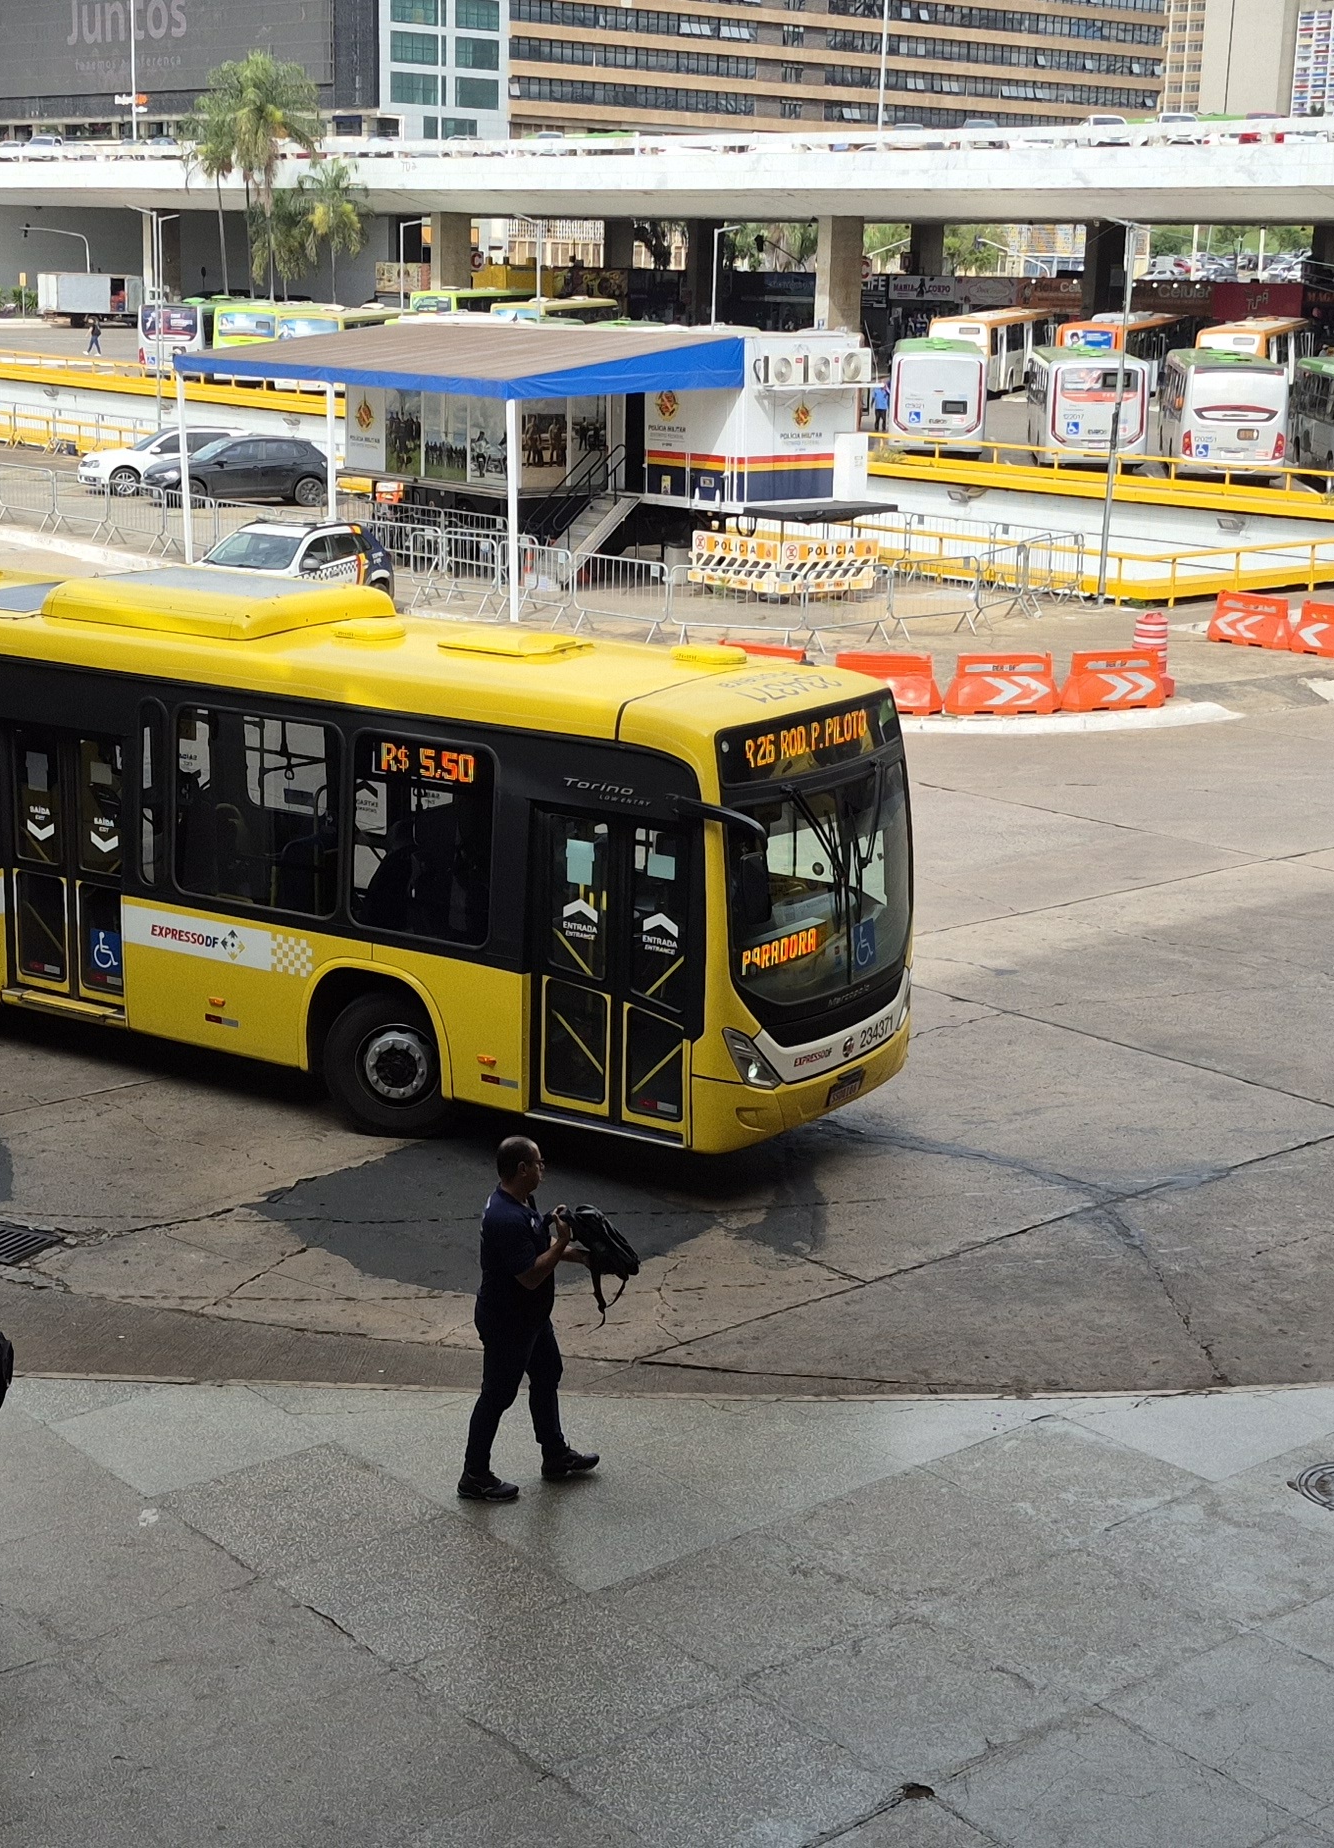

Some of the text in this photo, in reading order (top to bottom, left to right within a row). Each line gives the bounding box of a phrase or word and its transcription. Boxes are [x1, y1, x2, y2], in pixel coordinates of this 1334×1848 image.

[470, 252, 482, 269] C
[380, 742, 410, 773] R$
[563, 777, 635, 796] Torino
[599, 794, 652, 807] LOW ENTRY
[29, 805, 51, 817] SAÍDA
[93, 817, 115, 828] SAÍDA
[562, 920, 598, 935] ENTRADA
[150, 923, 219, 949] EXPRESSODF
[565, 930, 596, 942] ENTRANCE
[642, 934, 678, 949] ENTRADA
[644, 943, 676, 956] ENTRANCE
[859, 1013, 894, 1049] 234371
